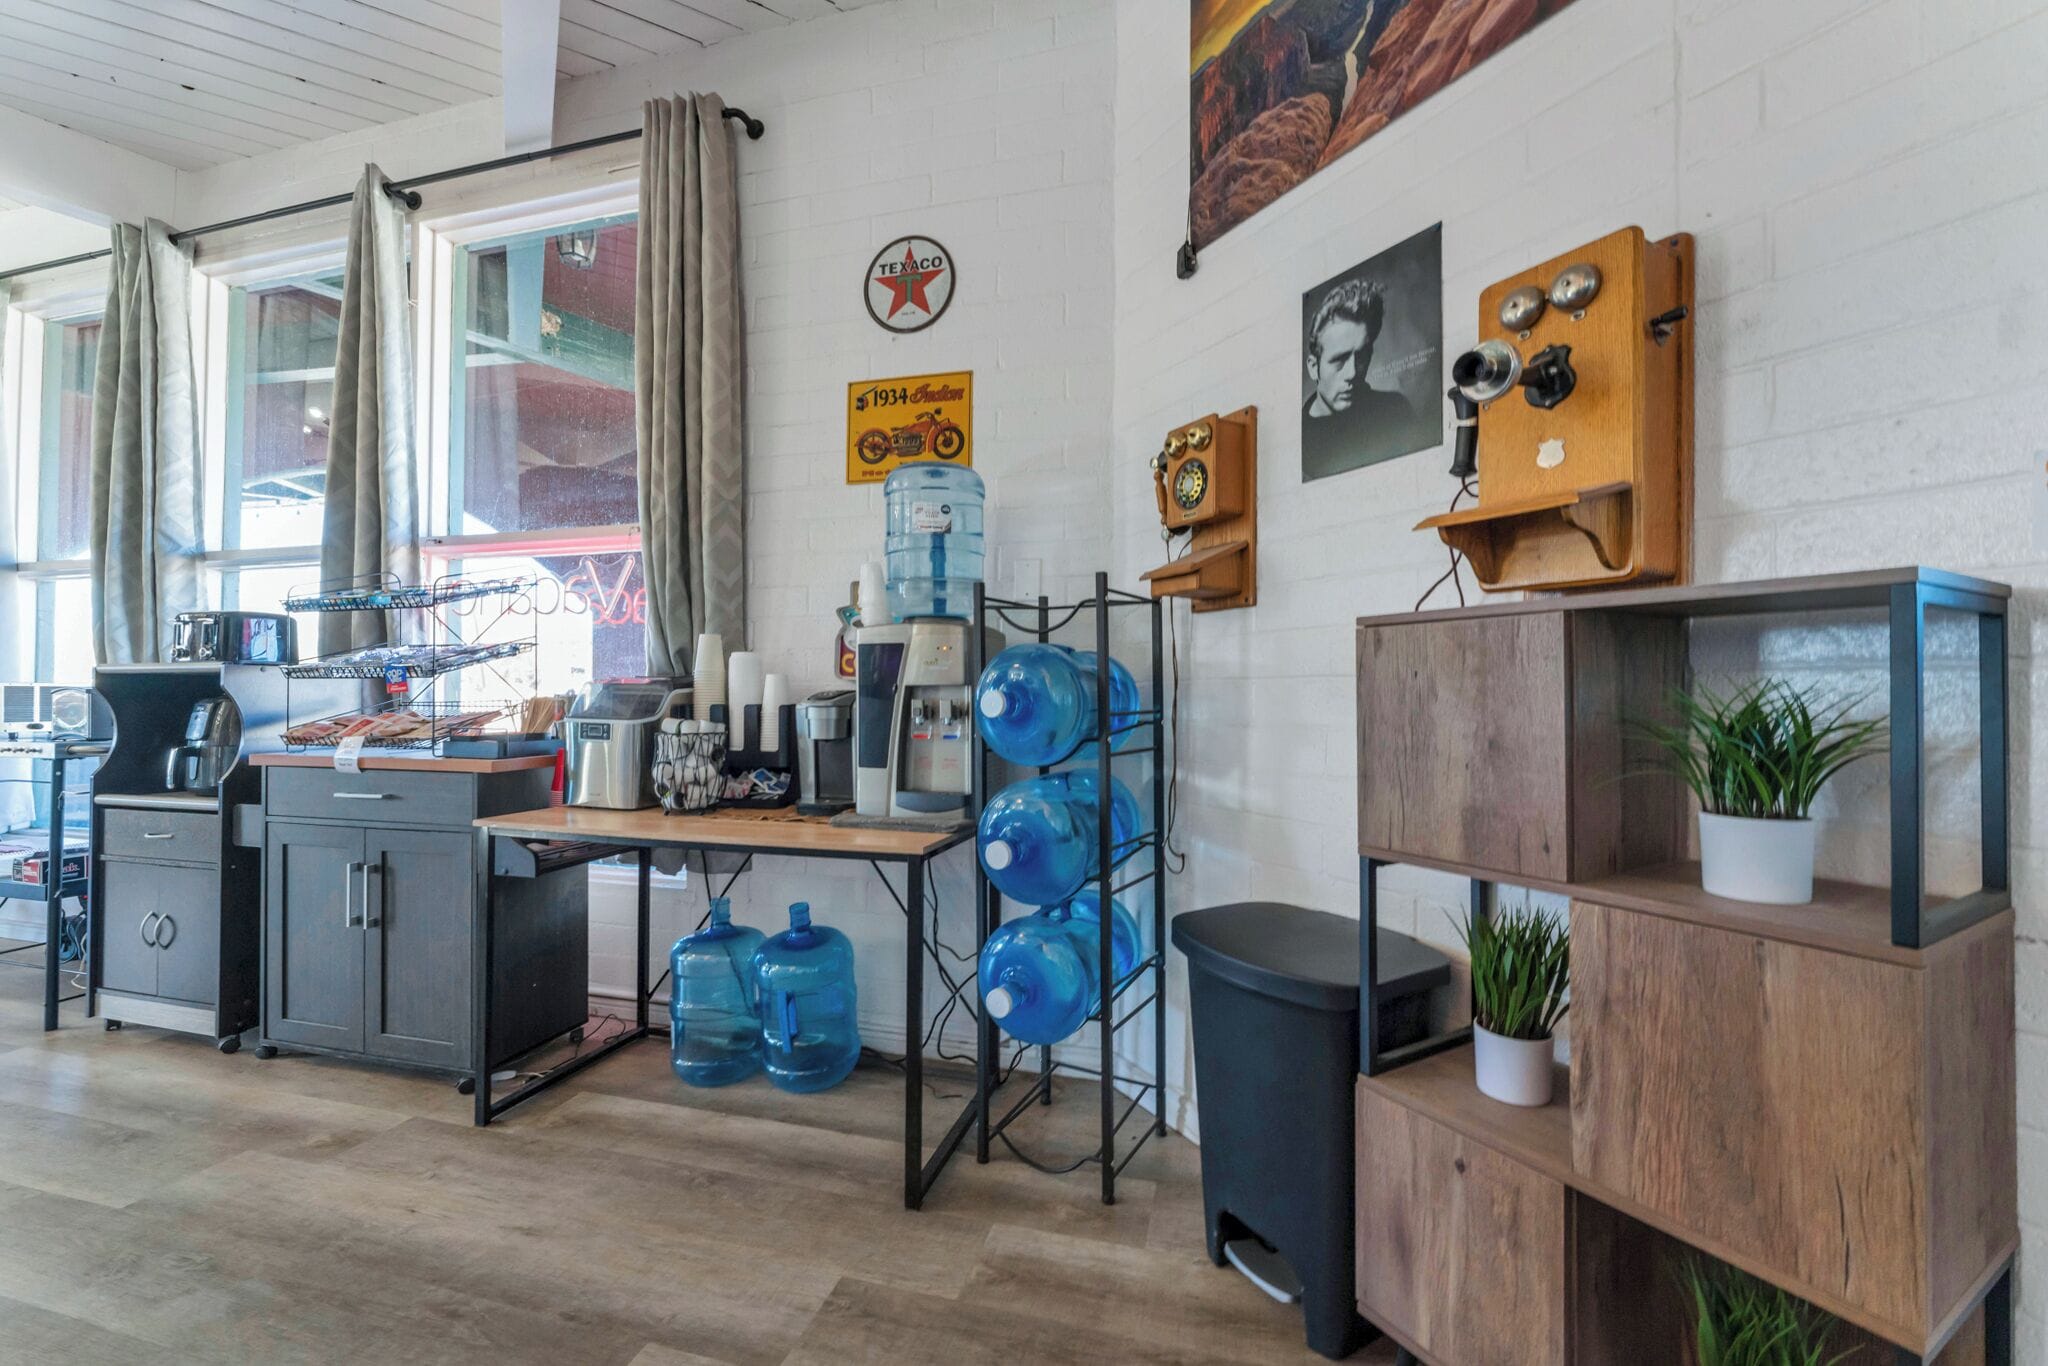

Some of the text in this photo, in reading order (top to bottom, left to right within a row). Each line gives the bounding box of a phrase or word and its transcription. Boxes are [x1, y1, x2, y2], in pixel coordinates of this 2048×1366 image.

[879, 256, 943, 276] TEXACO
[873, 383, 965, 408] 1934 Indian
